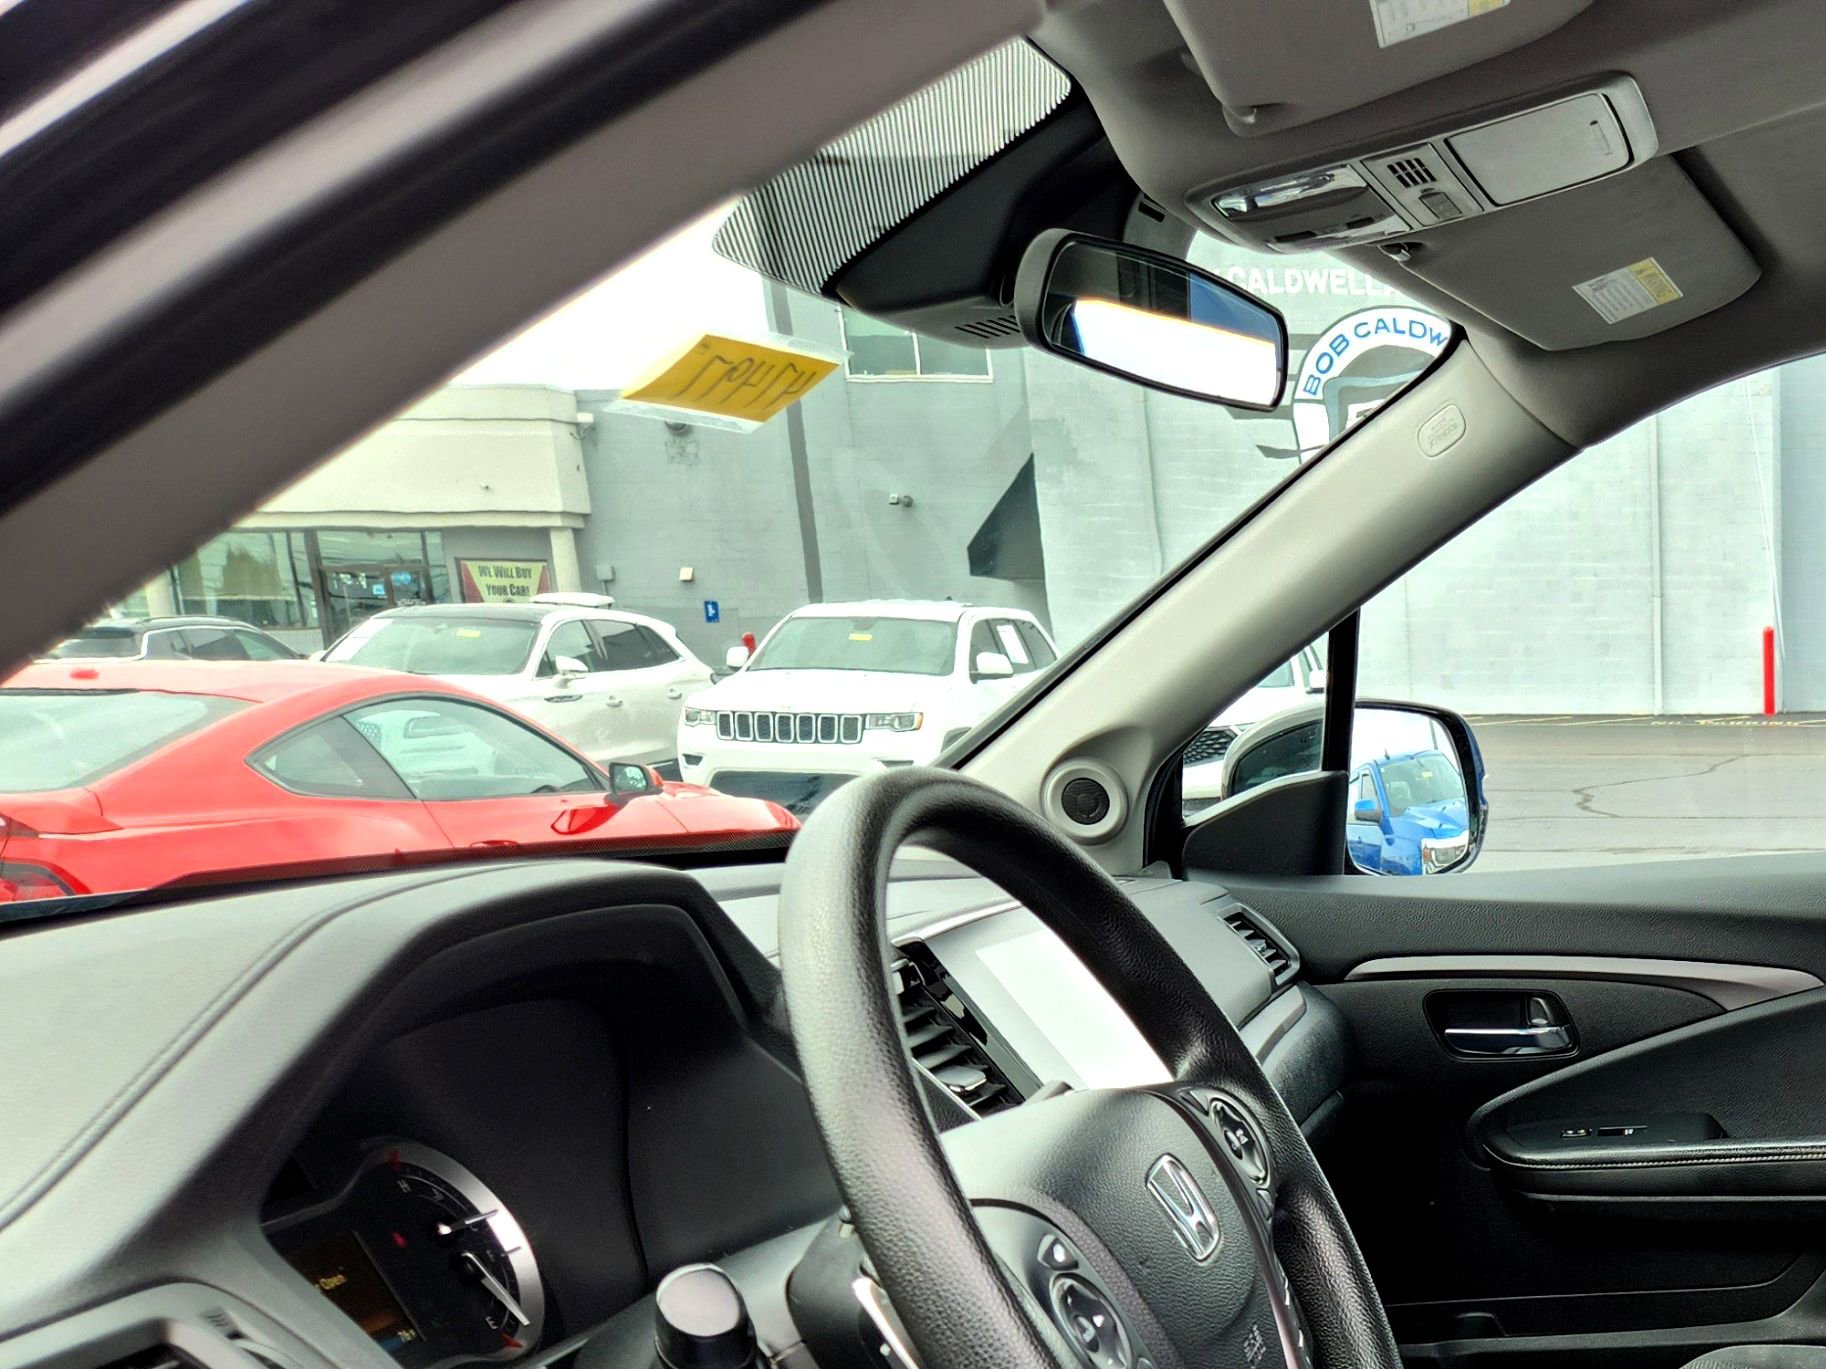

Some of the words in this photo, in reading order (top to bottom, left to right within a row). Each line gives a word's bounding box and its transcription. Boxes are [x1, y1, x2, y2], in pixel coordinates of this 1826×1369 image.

[1302, 333, 1350, 396] BOB
[494, 565, 514, 579] WILL
[485, 583, 509, 596] YOUR
